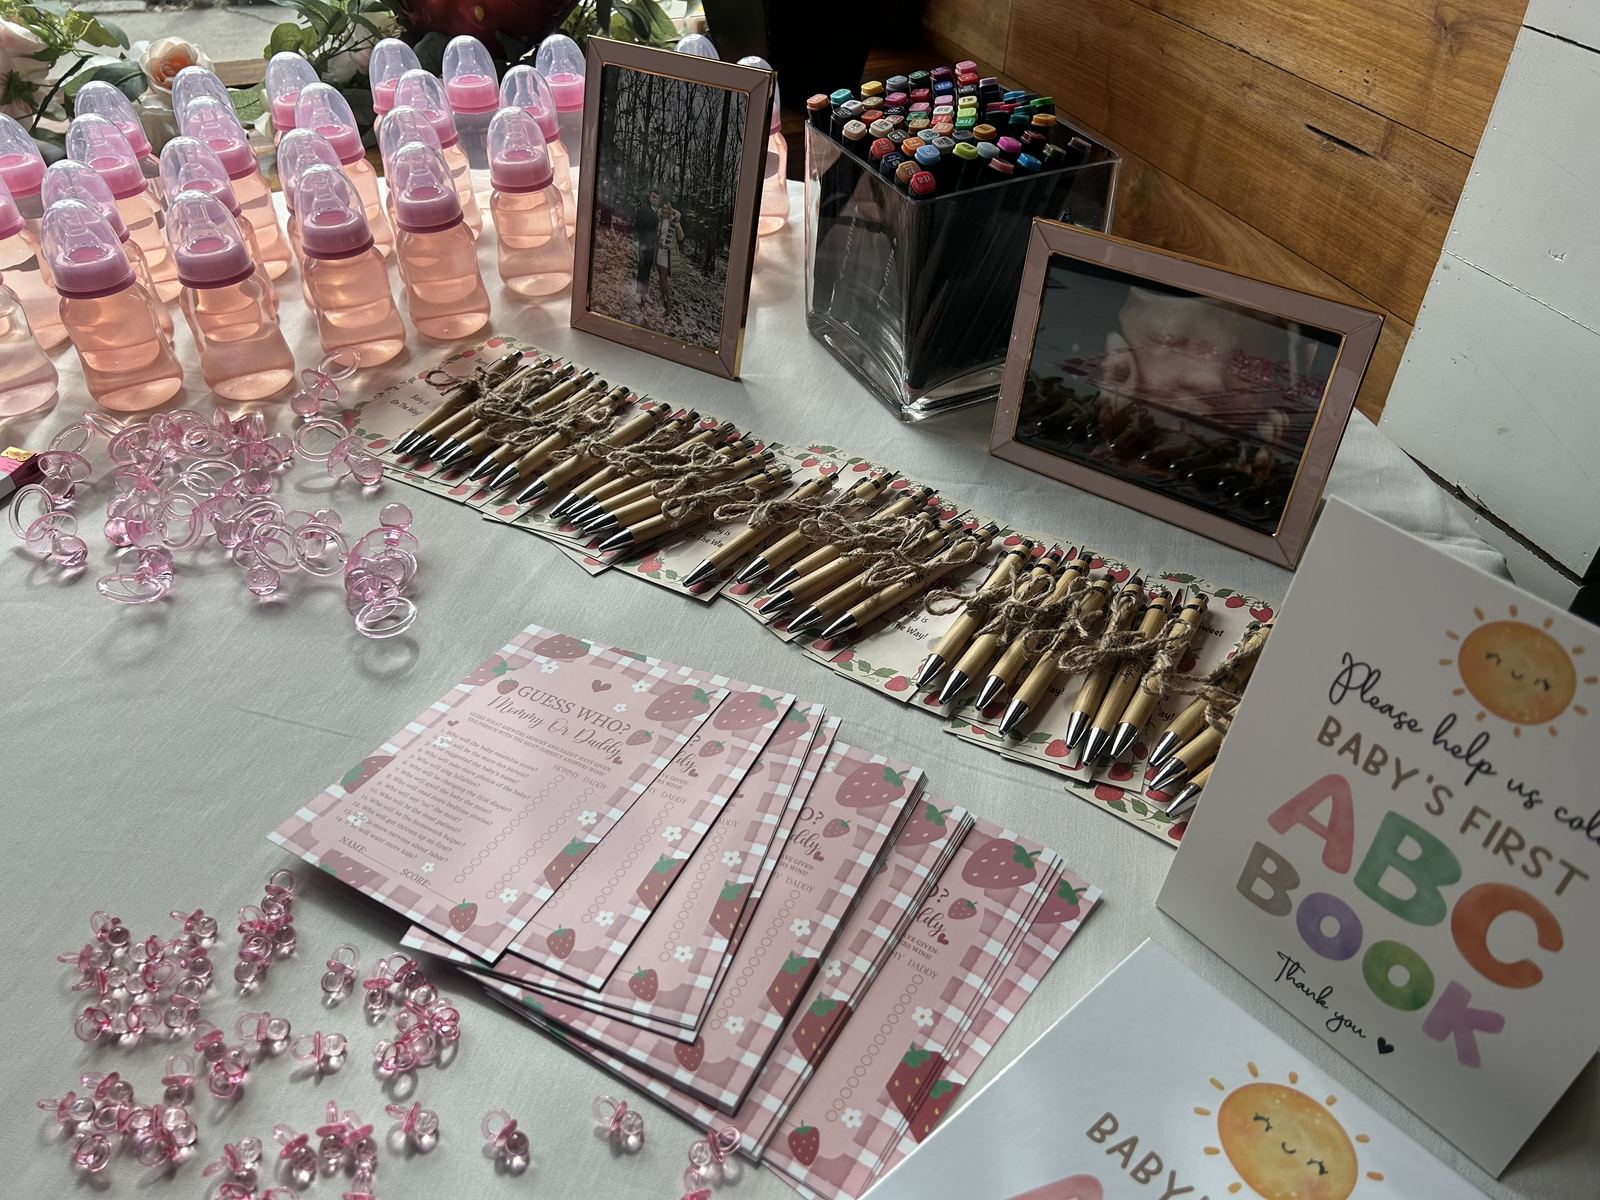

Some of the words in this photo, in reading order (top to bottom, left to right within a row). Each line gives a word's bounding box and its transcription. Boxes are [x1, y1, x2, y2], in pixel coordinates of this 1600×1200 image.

[711, 538, 724, 548] Wa
[920, 615, 929, 623] is
[906, 626, 929, 641] Way!
[1049, 686, 1065, 697] ay!
[517, 686, 576, 714] GUESS
[577, 706, 631, 735] WHO?
[1158, 707, 1176, 721] ay!
[487, 695, 545, 729] Mommy
[548, 717, 570, 736] Or
[573, 728, 624, 760] Daddy
[525, 735, 547, 745] MOMMY
[559, 748, 578, 758] DADDY
[1329, 652, 1423, 733] Please
[1432, 713, 1497, 787] help
[1507, 778, 1544, 809] us
[1554, 806, 1600, 847] col
[675, 750, 697, 773] ddy
[551, 764, 579, 778] MOMMY
[582, 776, 607, 790] DADDY
[799, 806, 824, 825] O?
[1317, 715, 1453, 816] BABY'S
[1459, 805, 1590, 896] FIRST
[340, 836, 367, 854] NAME:
[789, 829, 822, 856] ddy
[400, 869, 431, 889] SCORE:
[785, 877, 813, 893] DADDY
[1267, 774, 1564, 989] ABC
[927, 884, 949, 903] O?
[916, 907, 946, 936] ddy
[1236, 841, 1505, 1068] BOOK
[908, 959, 936, 979] DADDY
[1274, 951, 1333, 1009] Thank
[1325, 1011, 1366, 1039] you
[1086, 1111, 1210, 1200] BABY
